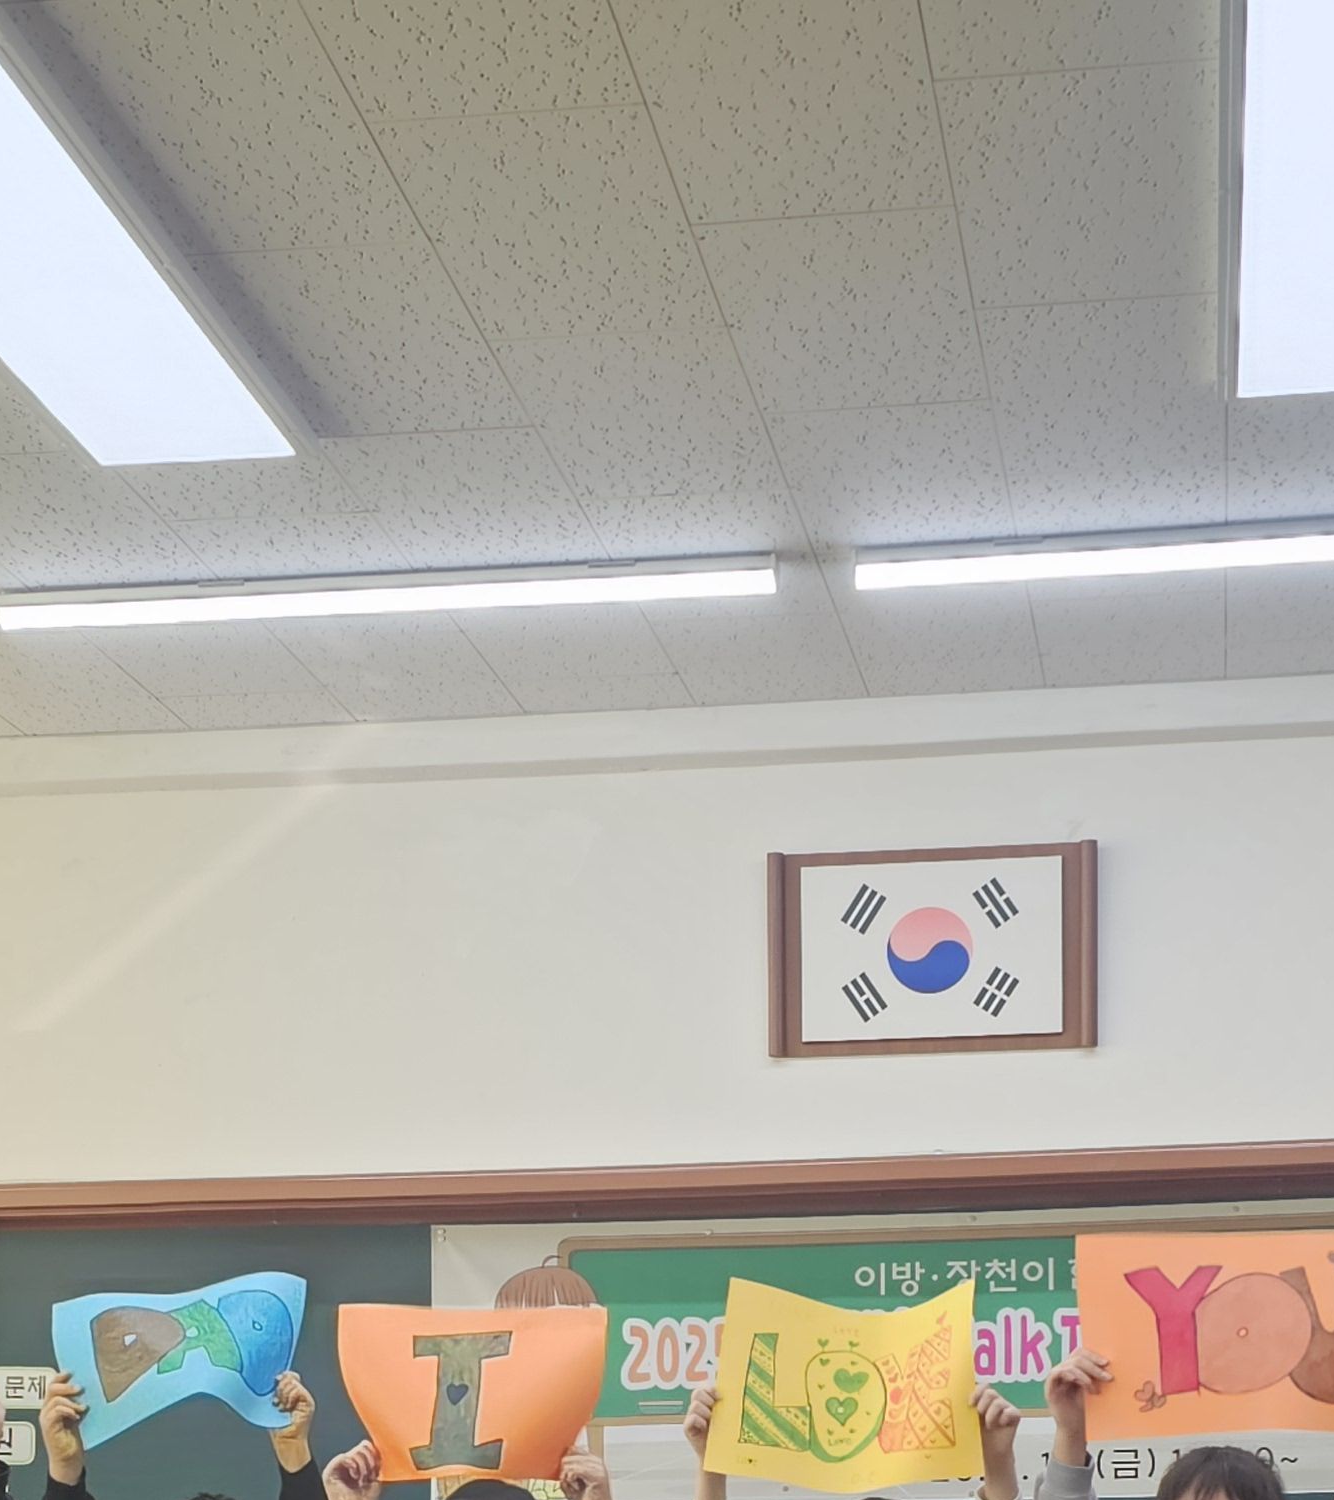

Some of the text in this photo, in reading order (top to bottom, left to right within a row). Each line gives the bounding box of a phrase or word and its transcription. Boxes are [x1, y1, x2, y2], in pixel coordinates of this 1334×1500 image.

[5, 1375, 47, 1400] 문제
[89, 1289, 295, 1404] DAD
[410, 1330, 512, 1471] I
[739, 1325, 956, 1463] LOVE
[973, 1314, 1045, 1377] alk
